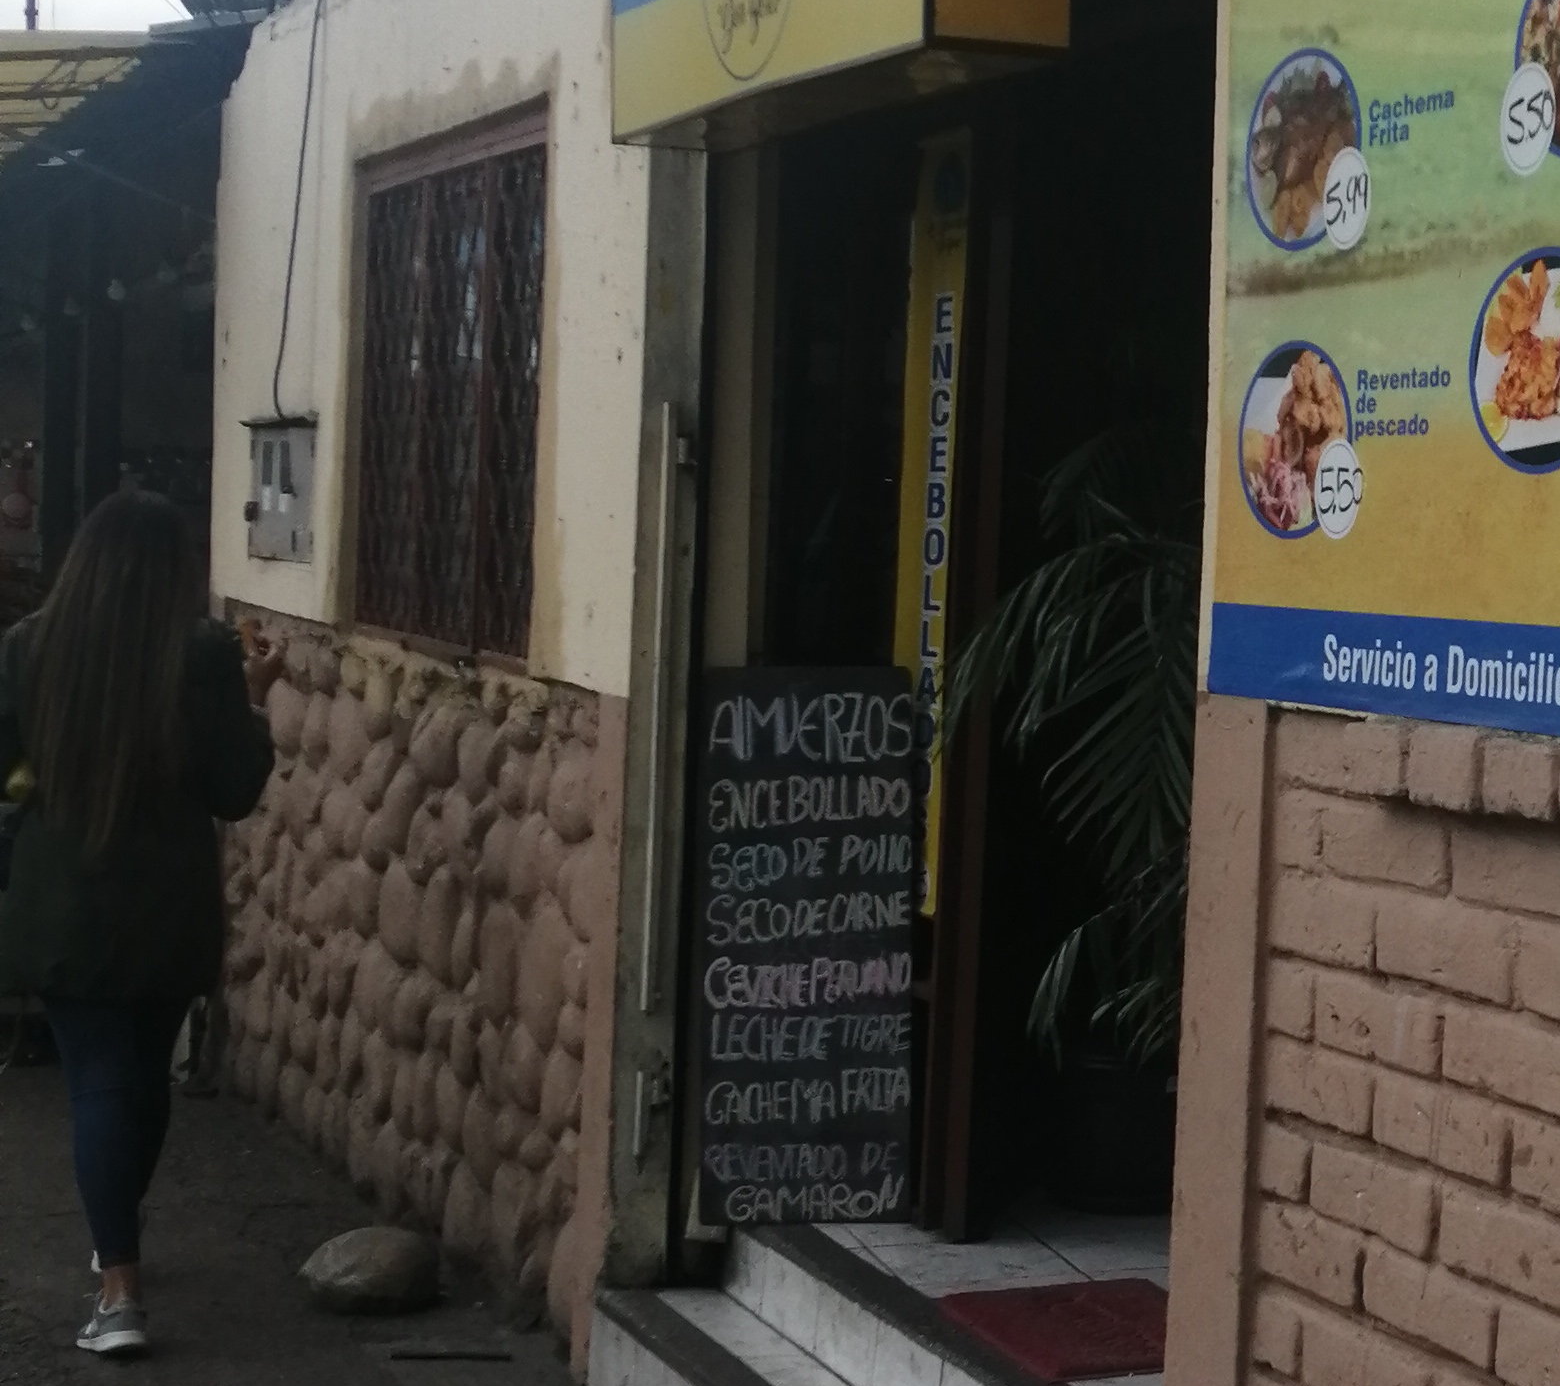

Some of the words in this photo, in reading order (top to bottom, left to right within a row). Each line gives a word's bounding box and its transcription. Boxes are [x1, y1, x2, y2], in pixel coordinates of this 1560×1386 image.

[1368, 89, 1456, 123] Cachema
[1368, 122, 1410, 147] Frita
[1356, 365, 1452, 392] Reventado
[1355, 393, 1378, 415] de
[1354, 414, 1430, 444] pescado
[1322, 632, 1417, 690] Servicio
[1423, 658, 1439, 692] a
[708, 774, 912, 833] ENCEBOLLADO
[709, 842, 788, 893] SECO
[793, 836, 830, 879] DE
[707, 893, 790, 947] SECO
[791, 898, 828, 938] DE
[828, 890, 911, 934] CARNE
[838, 1011, 912, 1056] TIGRE
[861, 1141, 899, 1176] DE
